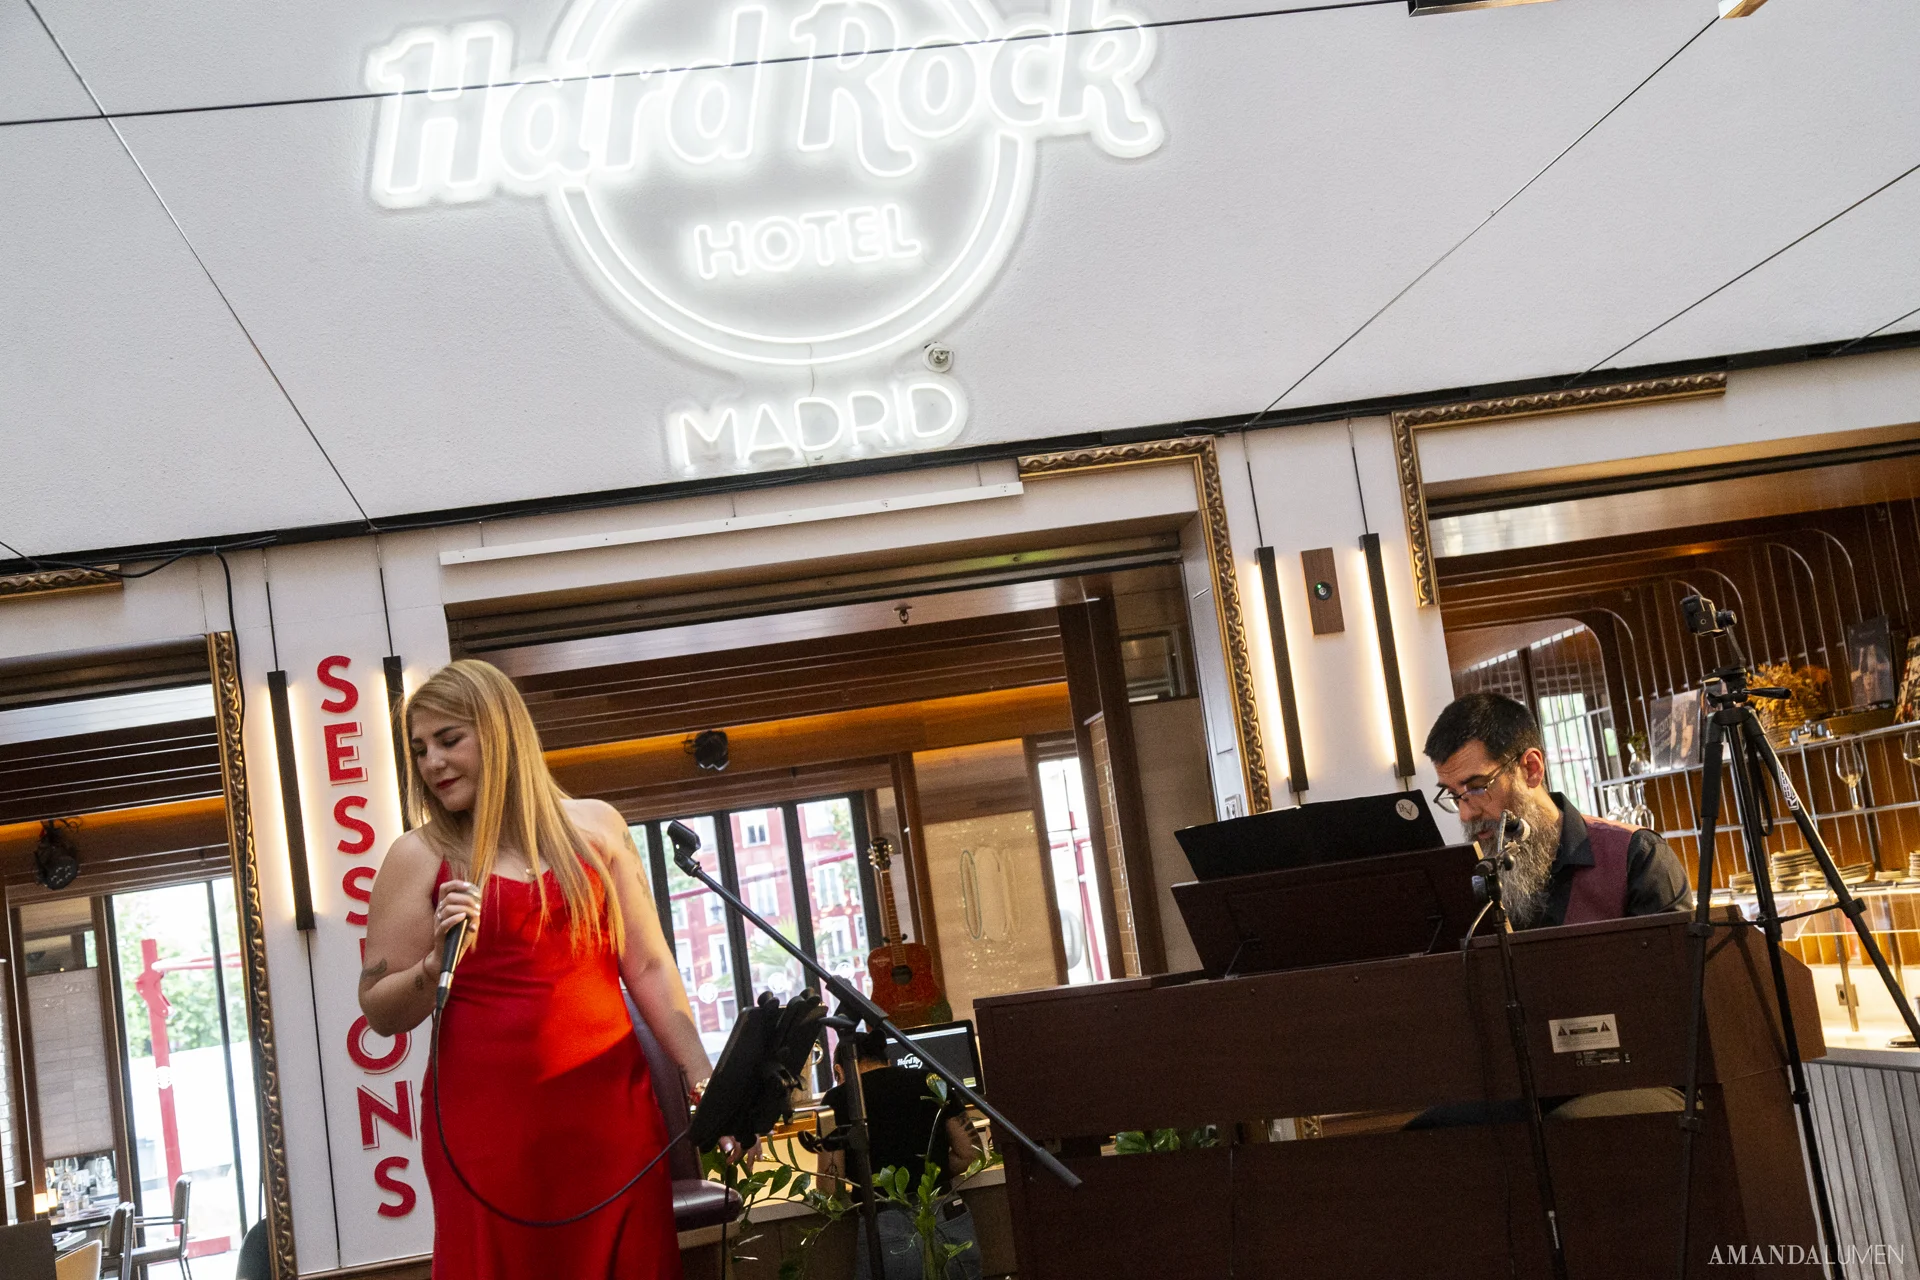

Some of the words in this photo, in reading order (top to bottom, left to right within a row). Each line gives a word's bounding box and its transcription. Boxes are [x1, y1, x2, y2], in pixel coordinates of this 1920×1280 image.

[374, 5, 770, 195] Hard
[788, 0, 1156, 179] Rock
[692, 202, 923, 281] HOTEL
[677, 382, 959, 475] MADRID
[316, 654, 422, 1219] SESSONS
